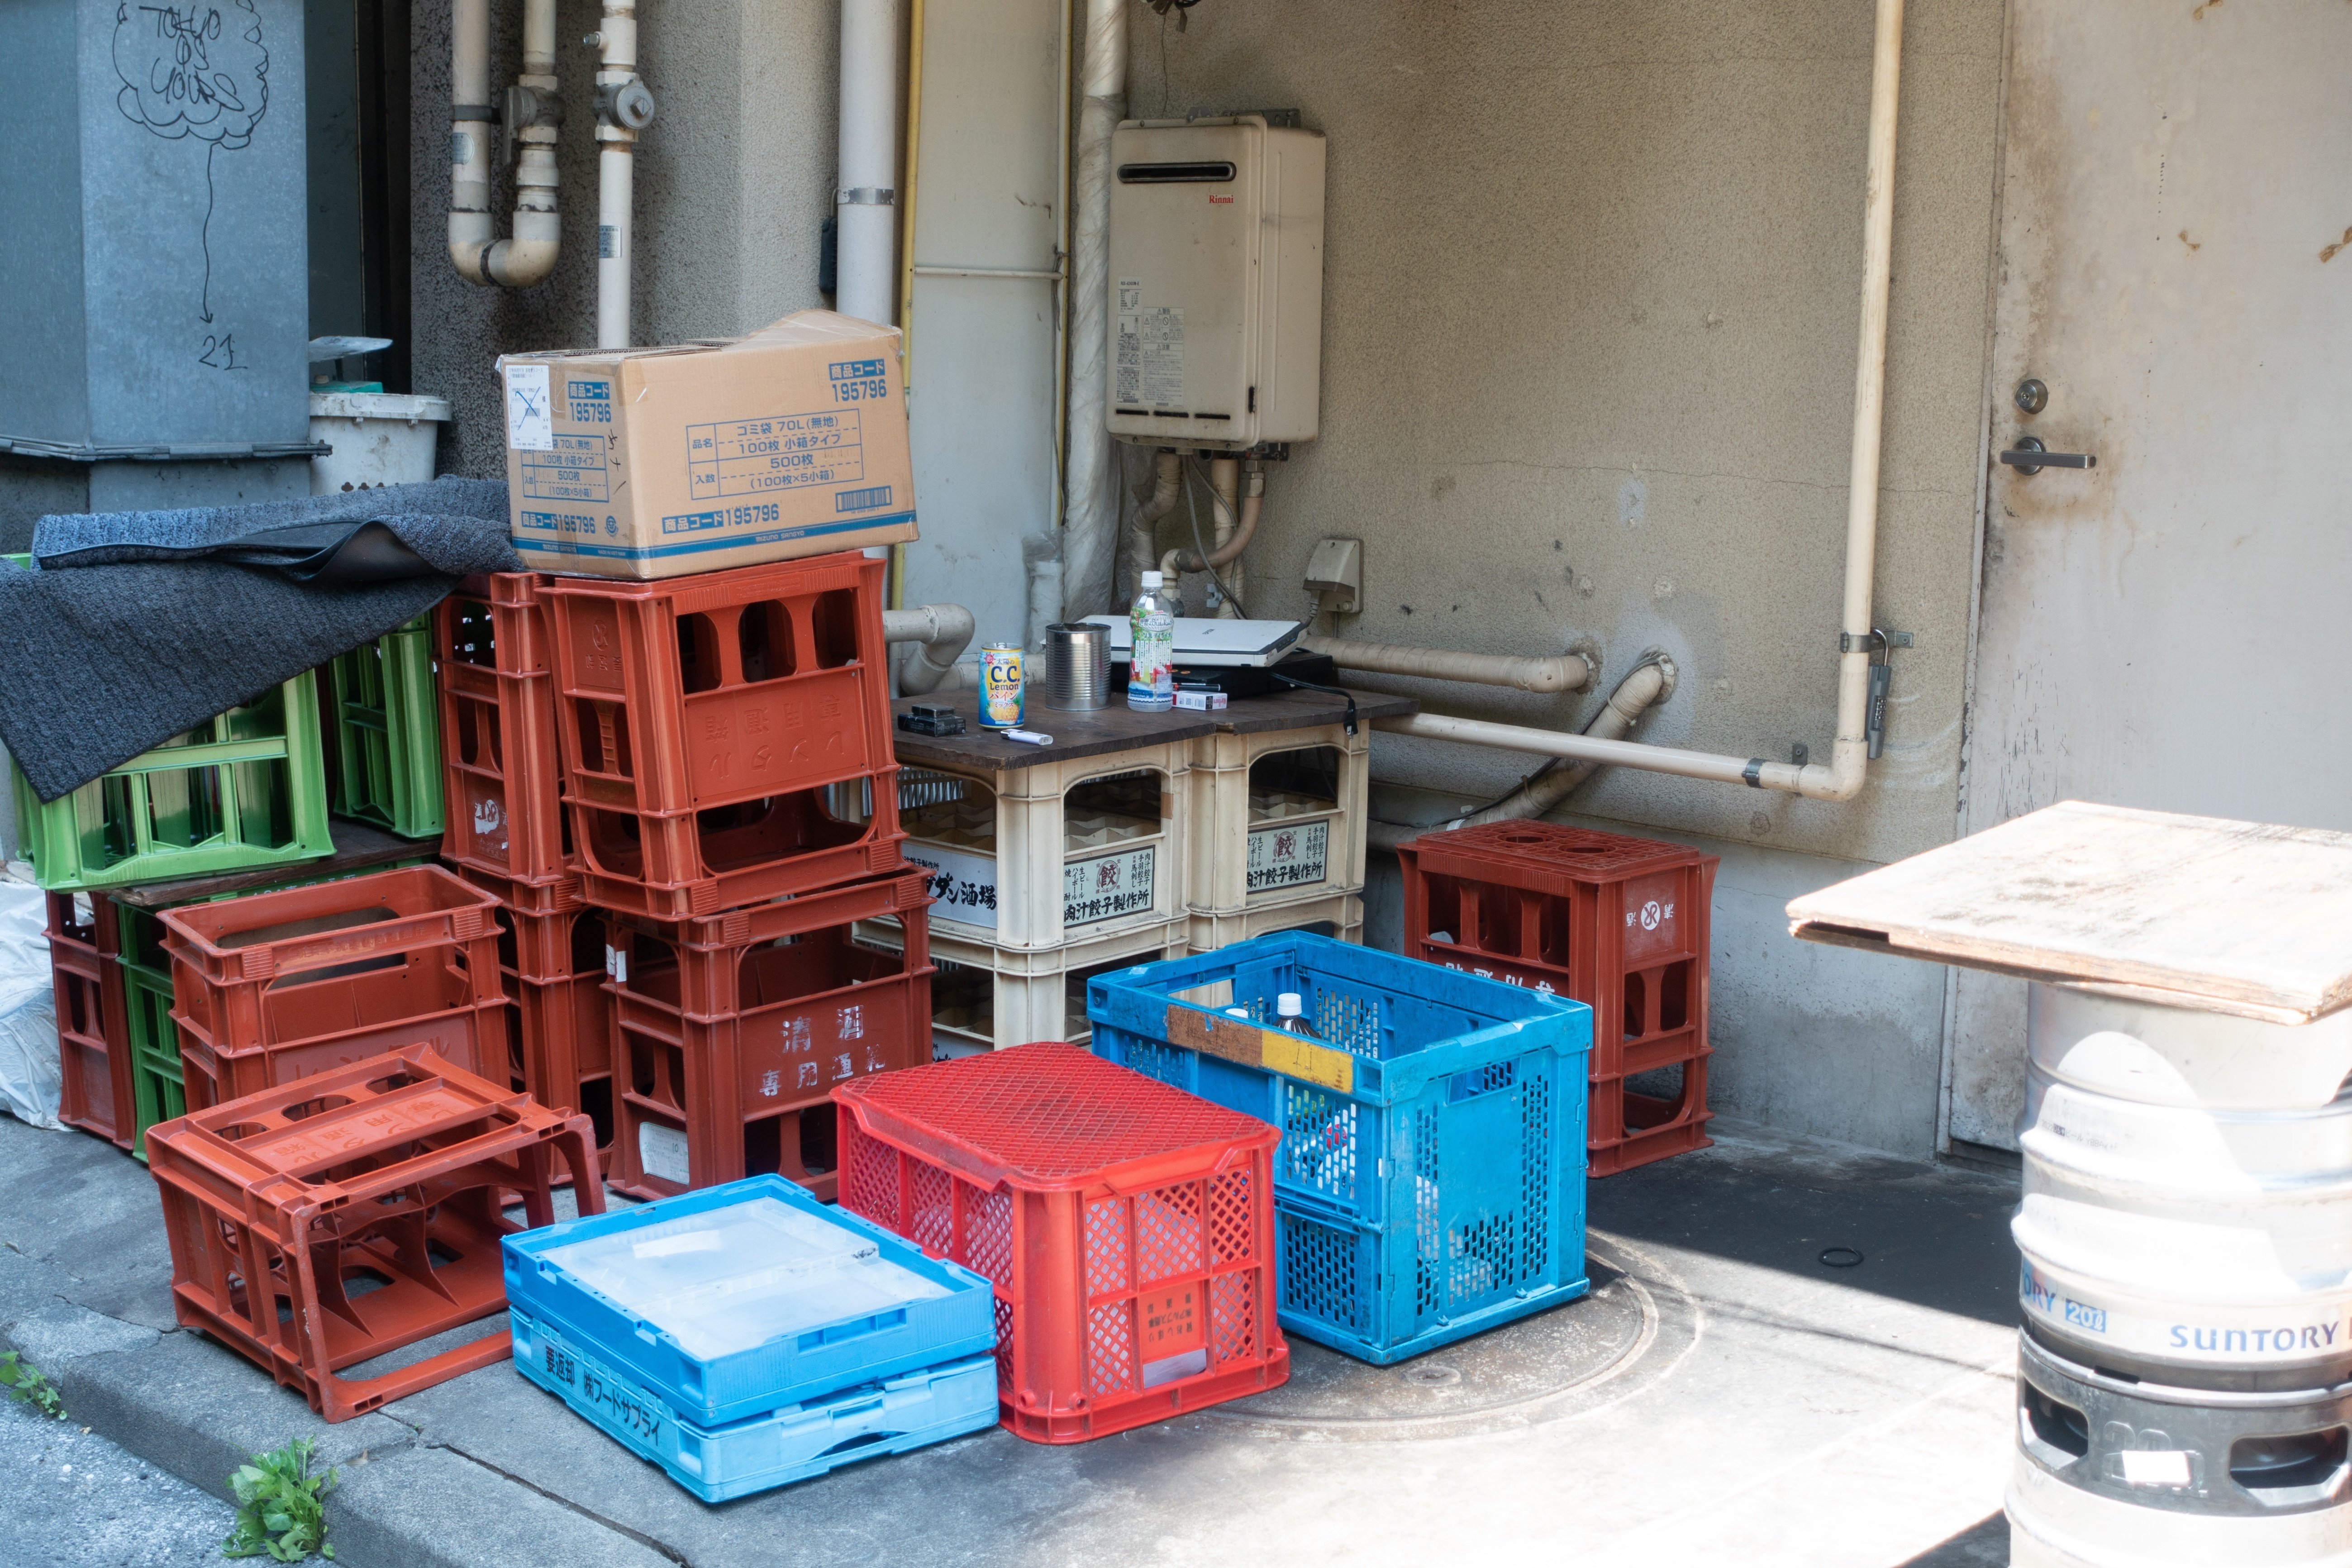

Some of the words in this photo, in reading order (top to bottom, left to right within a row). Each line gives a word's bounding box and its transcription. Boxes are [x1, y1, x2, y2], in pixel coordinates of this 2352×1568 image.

[139, 5, 221, 46] TOKYO
[1209, 195, 1233, 203] Rinnai
[198, 333, 248, 370] 21
[831, 361, 883, 379] 商品コード
[570, 383, 609, 397] 商品コード
[832, 379, 886, 402] 195796
[570, 402, 611, 422] 195796
[737, 423, 771, 436] ゴミ袋
[777, 416, 838, 432] 70L(無地)
[561, 440, 592, 451] 70L(無地)
[692, 438, 713, 449] 品名
[739, 440, 780, 454] 100枚
[785, 433, 841, 450] 小箱タイプ
[543, 455, 562, 464] 100枚
[565, 456, 594, 466] 小箱タイプ
[770, 454, 814, 469] 500枚
[558, 471, 580, 481] 500枚
[695, 474, 715, 485] 入数
[522, 513, 557, 528] 商品コード
[558, 514, 595, 534] 195796
[665, 512, 723, 532] 商品コード
[725, 503, 779, 527] 195796
[781, 530, 804, 539] SANGYO
[991, 666, 1020, 682] C.C.
[989, 691, 1018, 701] パイン
[1276, 836, 1293, 858] 餃
[1100, 864, 1116, 888] 餃
[1247, 860, 1323, 888] 肉汁餃子製作所
[1064, 888, 1149, 922] 肉汁餃子製作所
[1626, 911, 1636, 927] 酒
[1663, 904, 1674, 919] 清
[781, 1005, 863, 1054] 清酒
[2170, 1320, 2339, 1352] SUNTORY
[546, 1345, 575, 1387] 要返却
